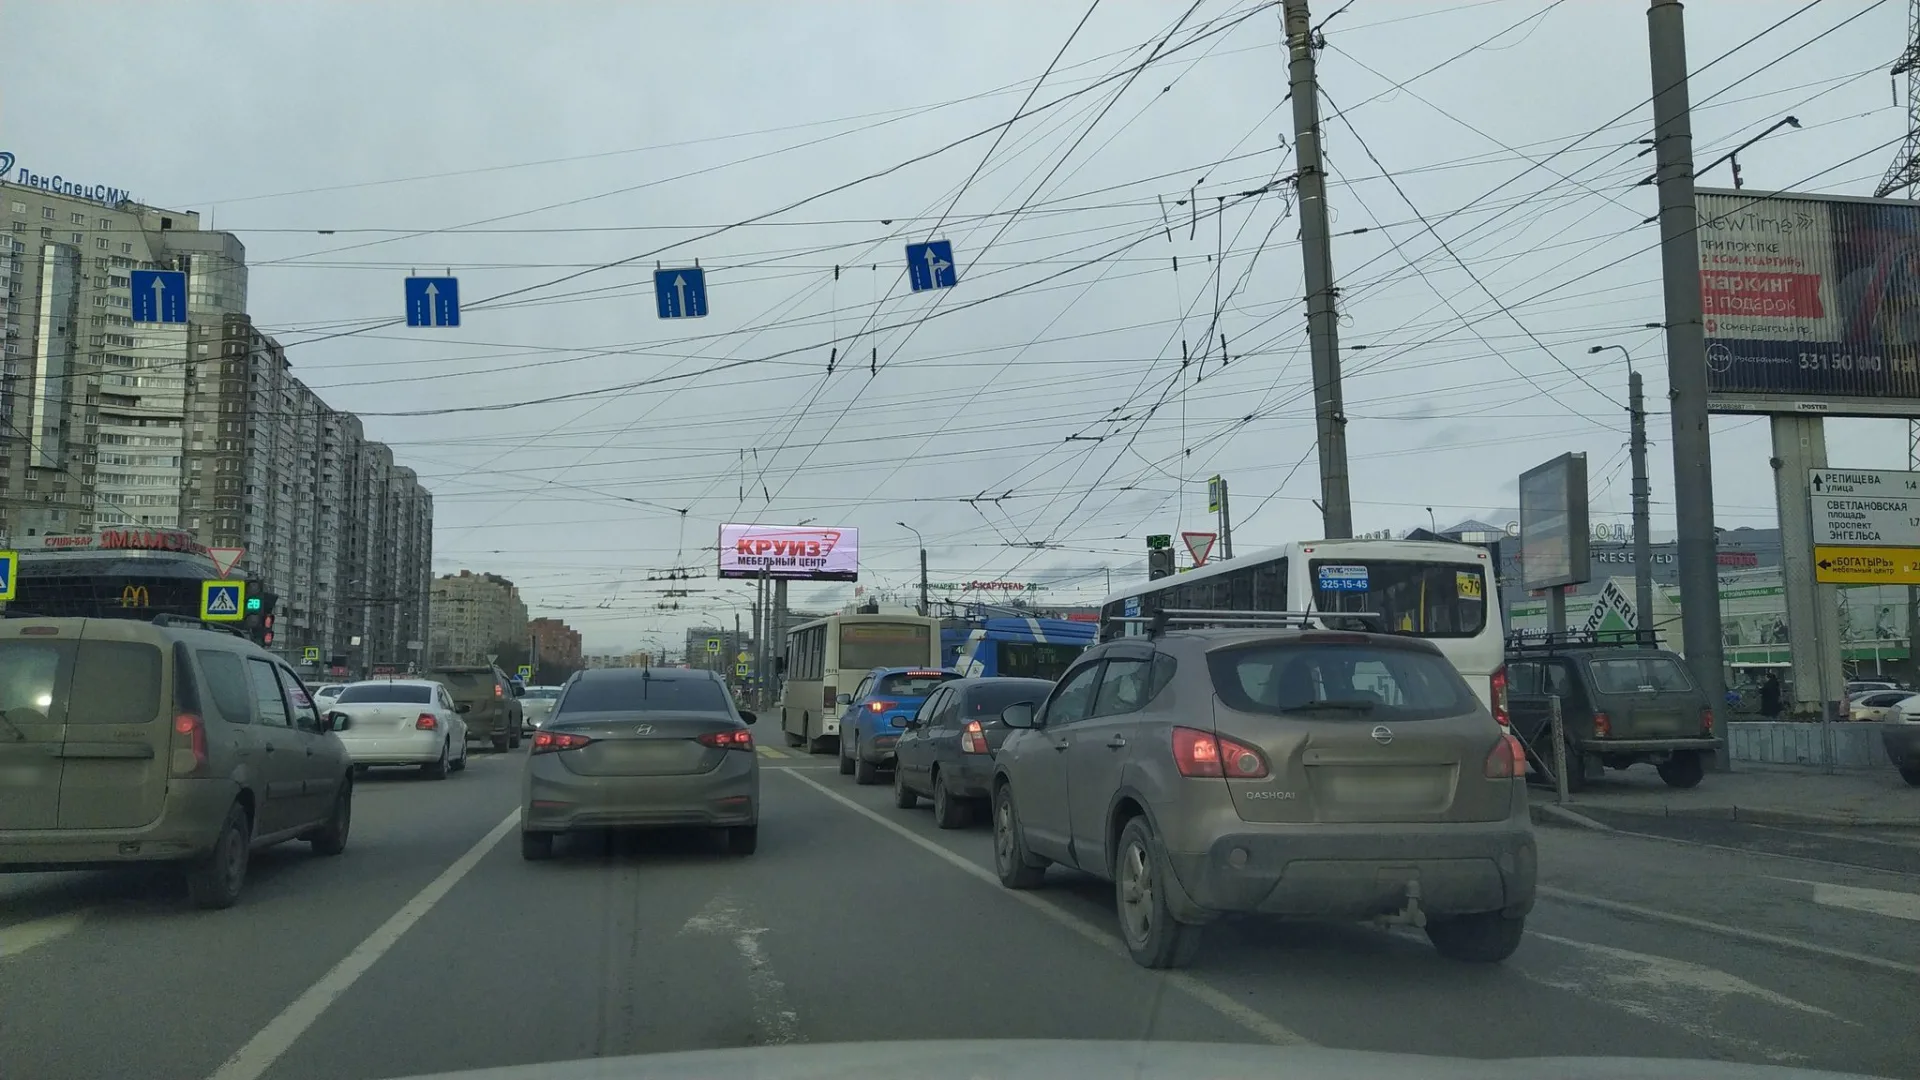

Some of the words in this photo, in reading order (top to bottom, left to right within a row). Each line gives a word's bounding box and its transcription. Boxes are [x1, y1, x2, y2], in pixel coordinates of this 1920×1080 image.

[18, 167, 129, 204] ЛенСпецСМУ
[1726, 242, 1779, 252] ПОКУПКЕ
[1720, 296, 1796, 314] подарок
[1826, 473, 1880, 484] РЕПИЩЕВА
[1826, 485, 1853, 493] улица
[1827, 500, 1908, 511] СВЕТЛАНОВСКАЯ
[1829, 521, 1871, 530] проспект
[1830, 530, 1881, 540] ЭНГЕЛЬСА
[44, 536, 93, 547] СУШИ-БАР
[737, 539, 821, 556] КРУИЗ
[738, 556, 796, 567] МЕБЕЛЬНЫЙ
[799, 558, 827, 567] ЦЕНТР
[1831, 557, 1894, 567] «БОГАТЫРЬ»
[1874, 567, 1894, 575] центр
[1321, 580, 1368, 589] 325-15-45
[247, 599, 261, 609] 28
[1246, 791, 1296, 800] QASHQAI
